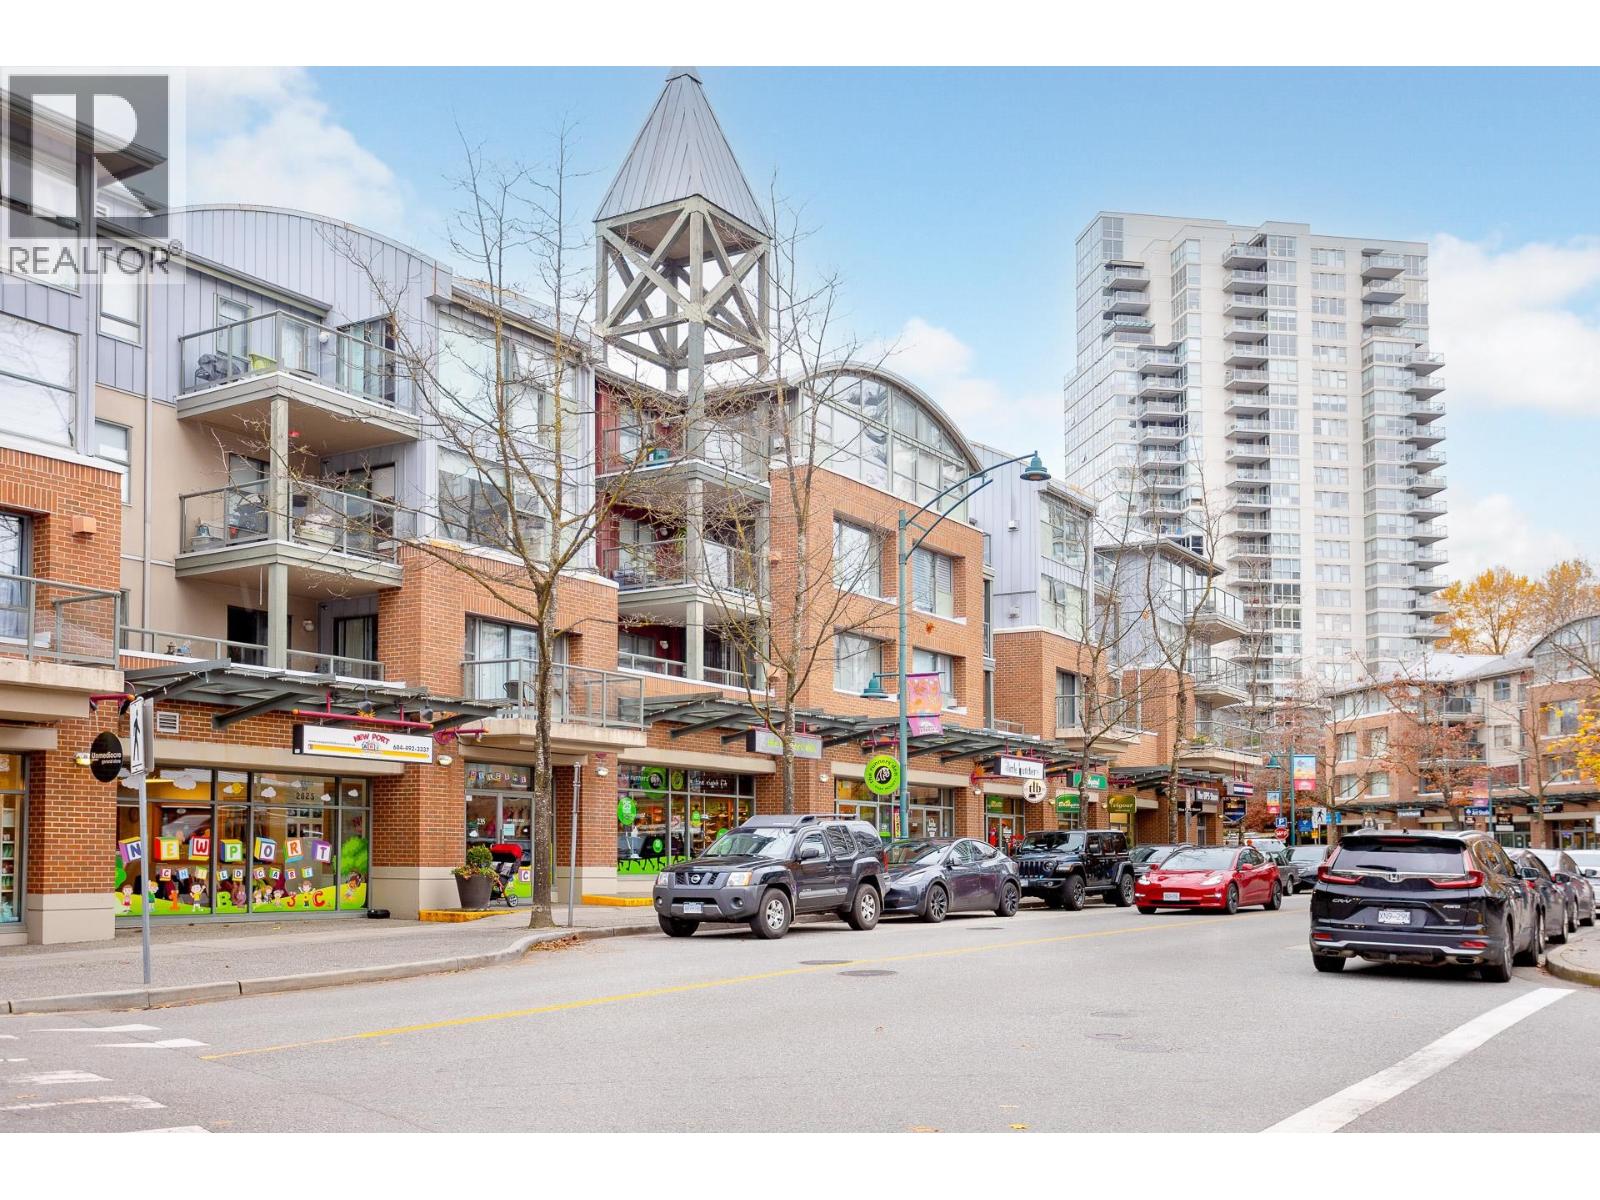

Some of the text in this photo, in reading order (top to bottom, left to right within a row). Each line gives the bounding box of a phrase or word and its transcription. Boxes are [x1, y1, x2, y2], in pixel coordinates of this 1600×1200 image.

[353, 733, 390, 745] NEW PORT
[313, 891, 325, 907] C
